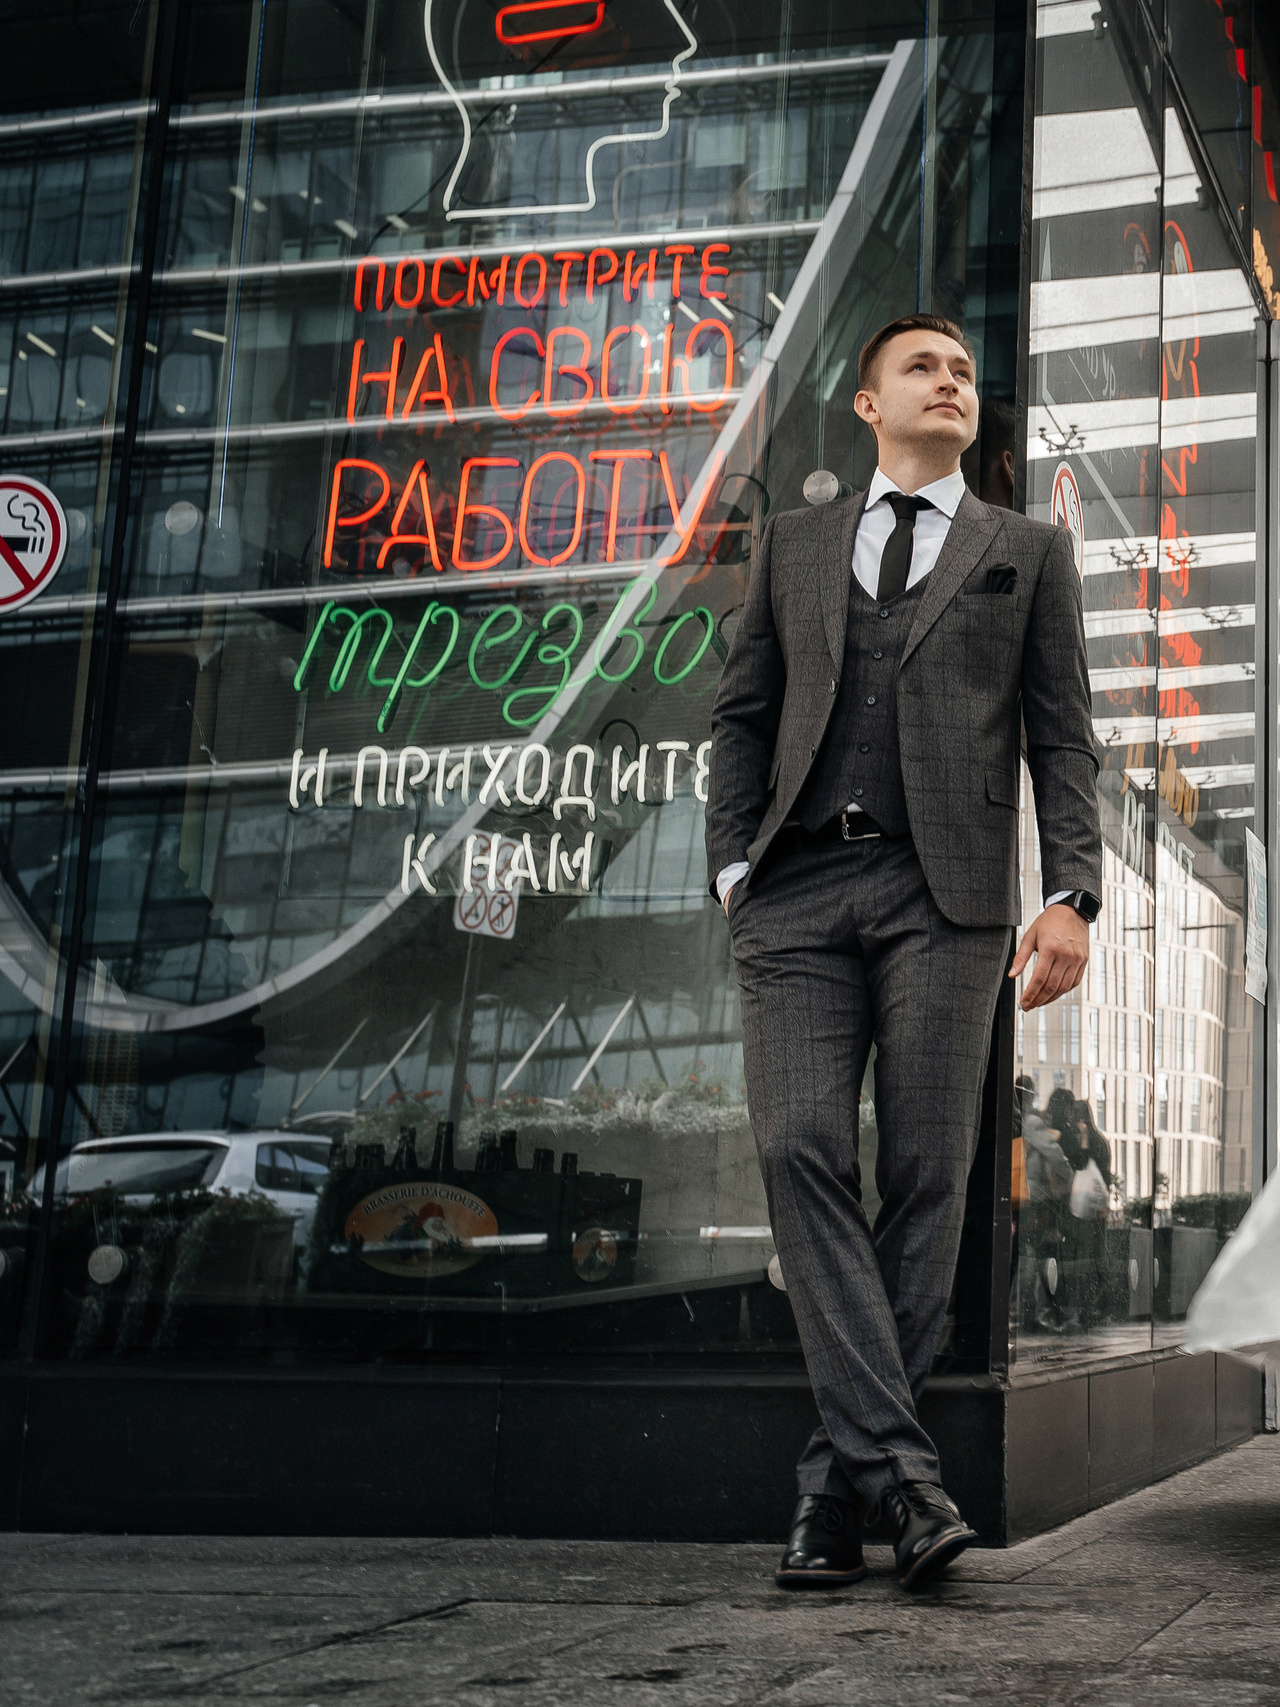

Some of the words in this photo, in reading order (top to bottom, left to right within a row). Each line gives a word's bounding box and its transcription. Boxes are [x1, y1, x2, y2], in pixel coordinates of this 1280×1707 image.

[353, 243, 732, 313] ПОСМОТРИТЕ
[347, 332, 456, 425] НА
[489, 318, 734, 420] СВОЮ
[324, 451, 727, 571] РАБОТУ
[293, 577, 715, 733] трезво
[289, 747, 329, 808] И
[401, 832, 438, 896] К
[463, 830, 596, 894] НАМ
[363, 1186, 419, 1215] BRASSERIE
